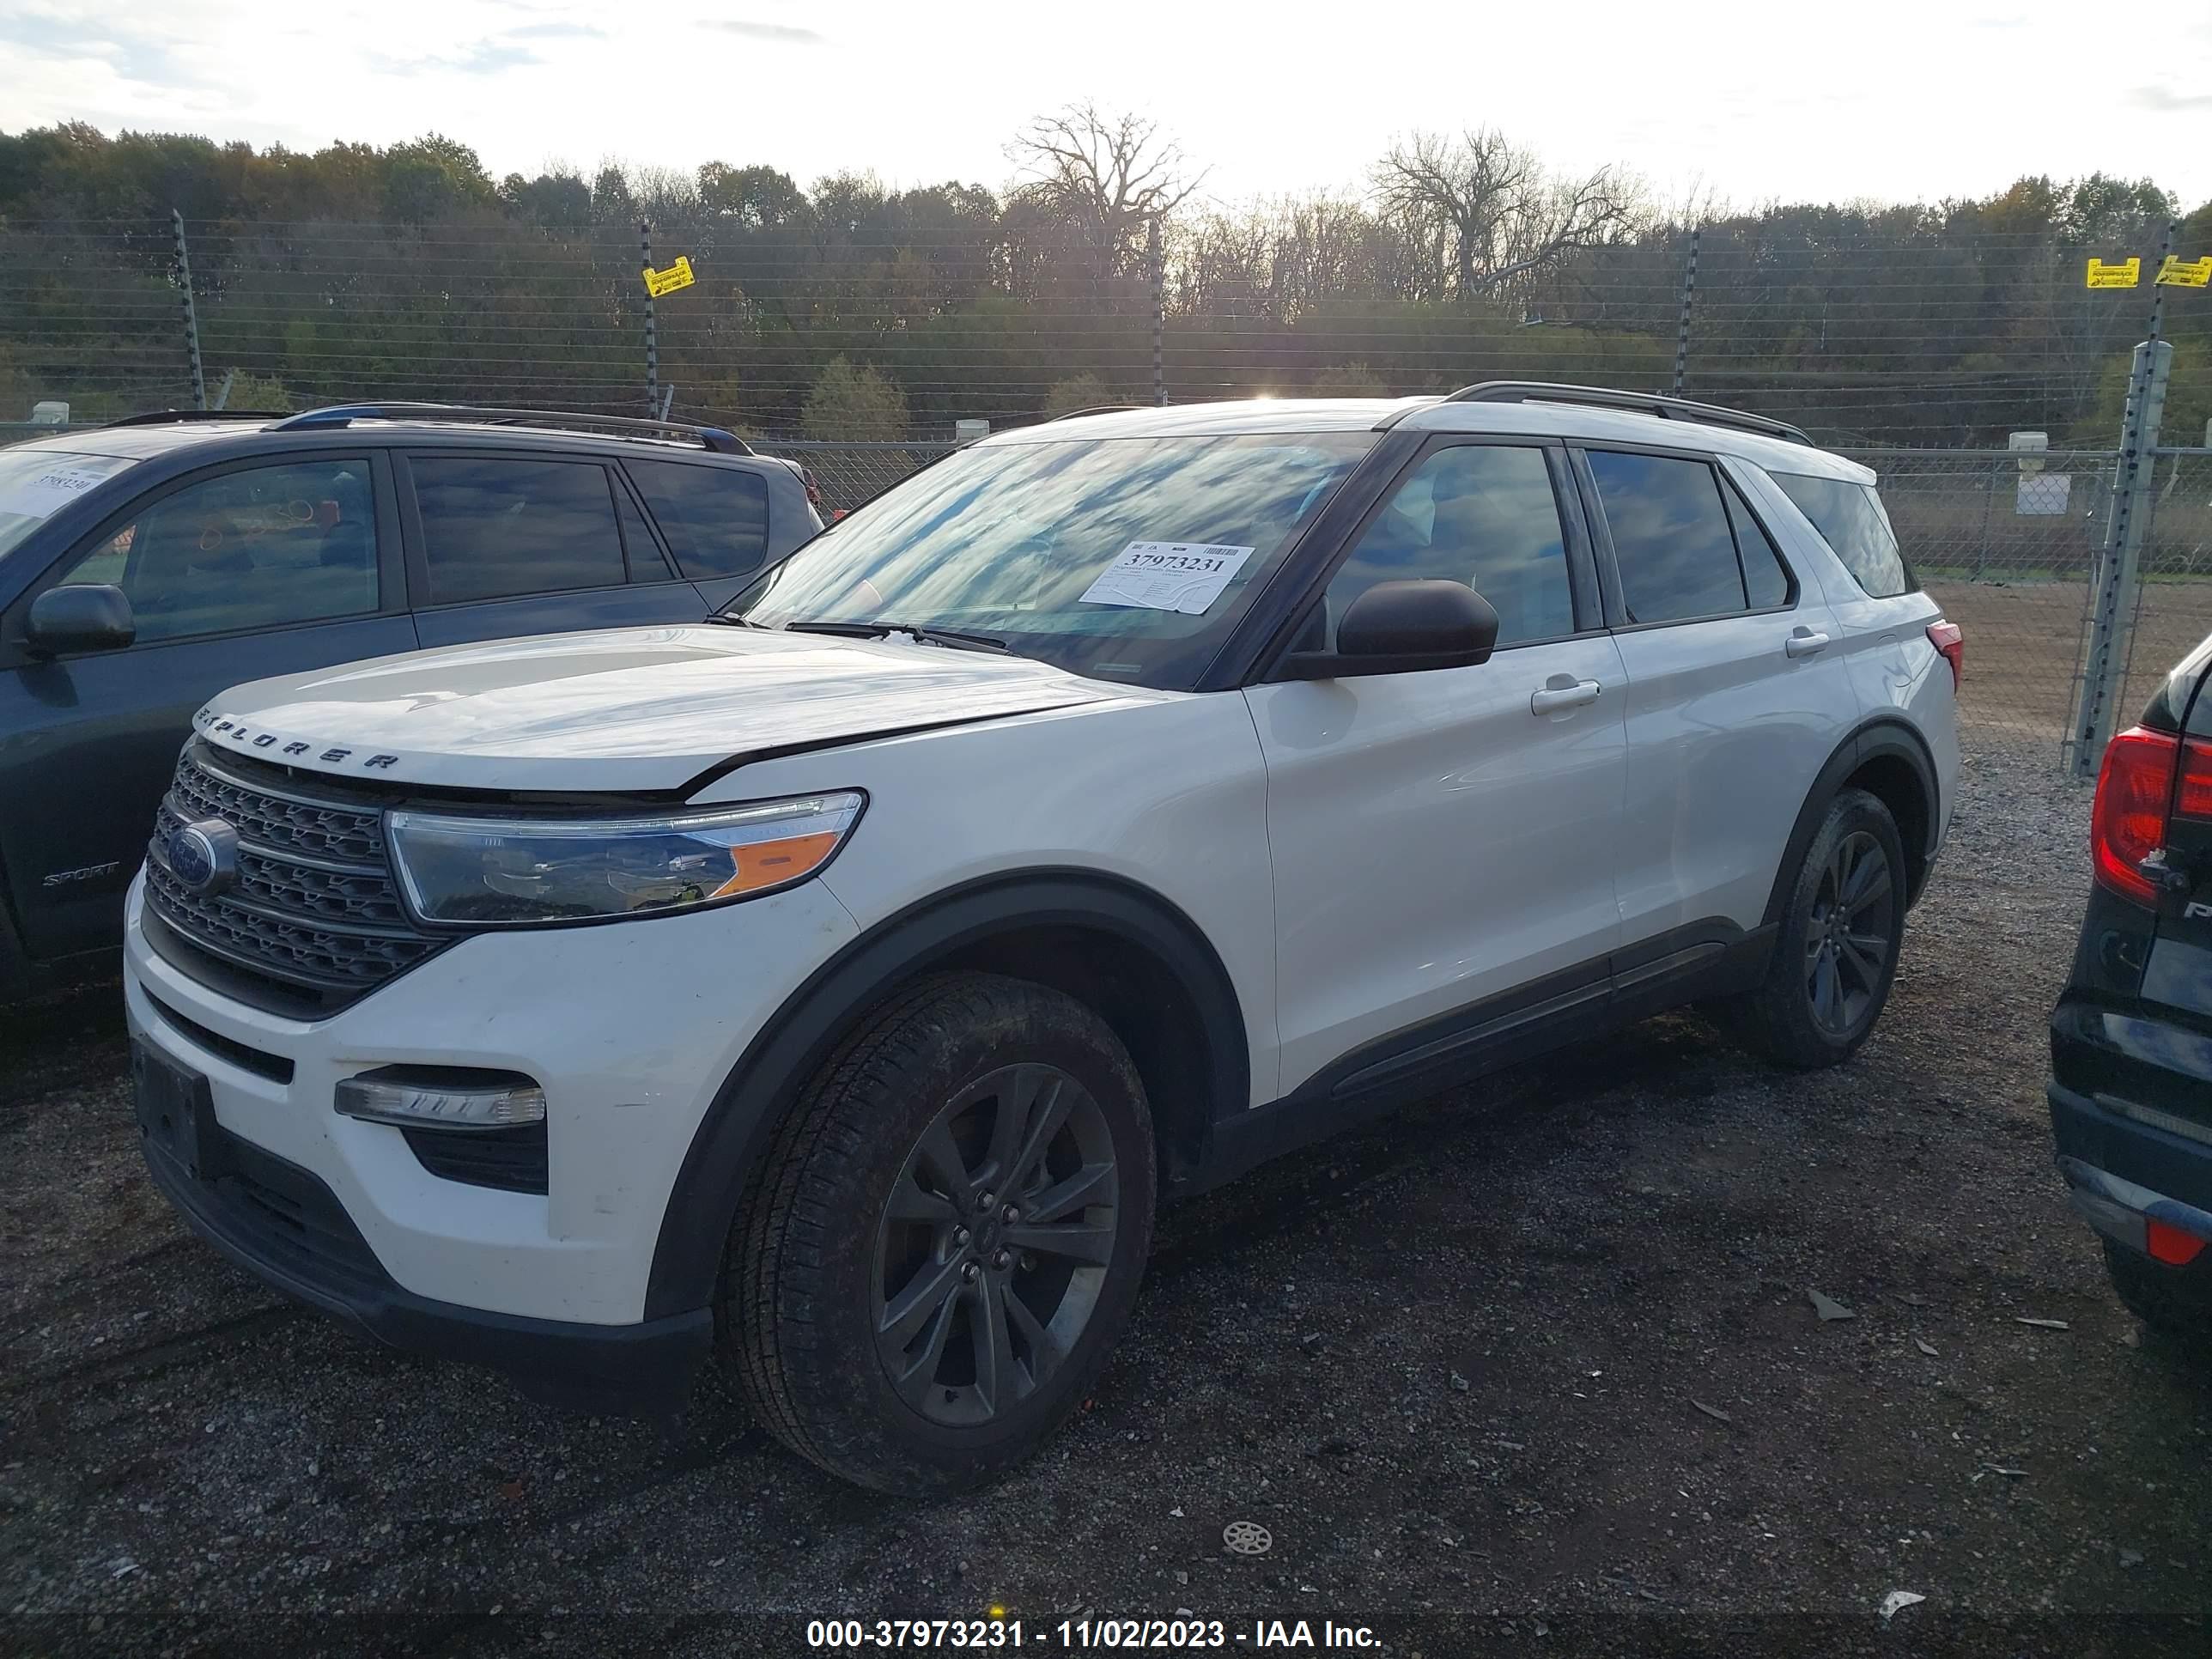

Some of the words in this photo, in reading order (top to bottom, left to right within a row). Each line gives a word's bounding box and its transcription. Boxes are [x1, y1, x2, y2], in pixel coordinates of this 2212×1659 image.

[1124, 554, 1224, 572] 37973231
[198, 708, 398, 769] EXPLORER
[43, 861, 120, 886] SPORT
